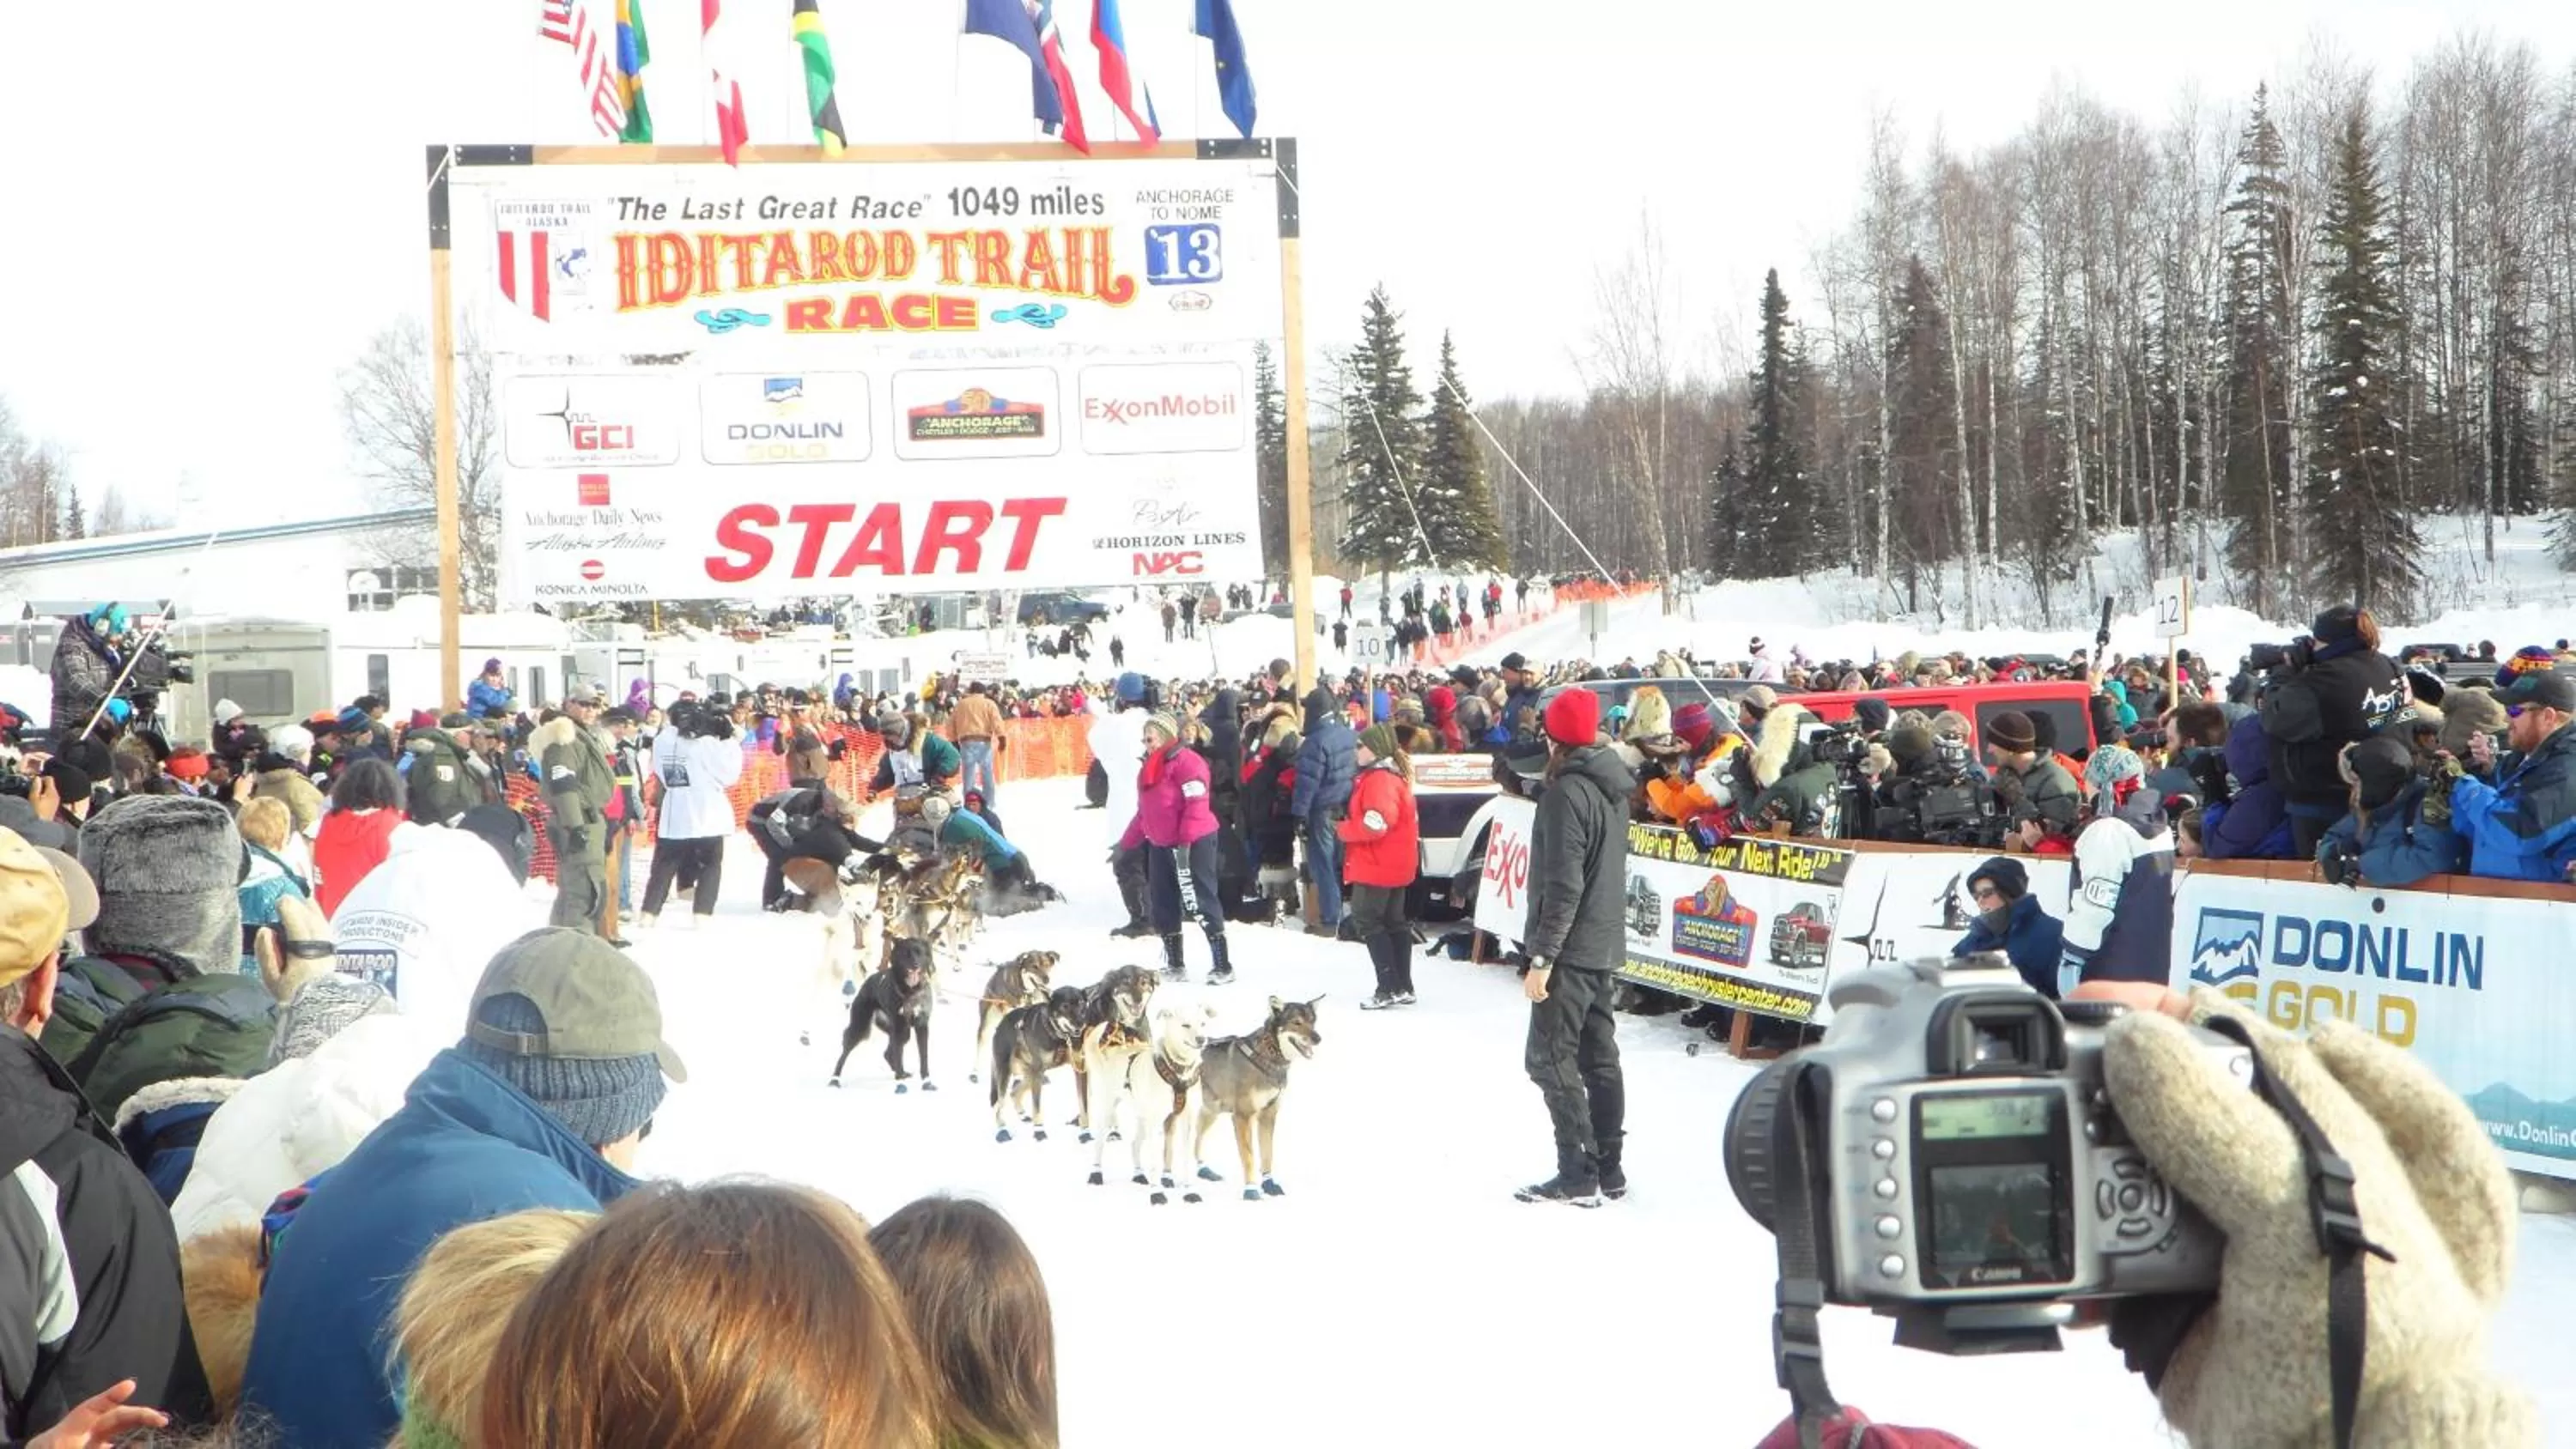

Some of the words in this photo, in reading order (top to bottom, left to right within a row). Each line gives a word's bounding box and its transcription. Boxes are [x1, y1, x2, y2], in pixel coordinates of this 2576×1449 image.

[681, 197, 744, 221] Last
[758, 195, 837, 220] Great
[947, 187, 1019, 216] 1049
[1030, 186, 1105, 215] miles
[1136, 190, 1234, 203] ANCHORAGE
[1151, 207, 1169, 220] TO
[1176, 205, 1222, 220] NOME
[612, 230, 916, 311] IDITAROD
[926, 226, 1138, 308] TRAIL
[783, 292, 979, 333] RACE
[1085, 393, 1236, 425] ExxonMobil
[573, 424, 635, 450] GCI
[728, 421, 843, 440] DONLIN
[525, 510, 587, 527] Anchorage
[592, 506, 624, 529] Daily
[630, 506, 663, 525] News
[704, 497, 1067, 582] START
[1107, 534, 1186, 549] HORIZON
[1193, 530, 1247, 546] LINES
[1132, 549, 1205, 576] NAC
[534, 584, 586, 596] KONICA
[590, 583, 648, 596] MINOLTA
[2158, 594, 2179, 625] 12
[1356, 637, 1380, 657] 10
[2273, 915, 2484, 990] DONLIN
